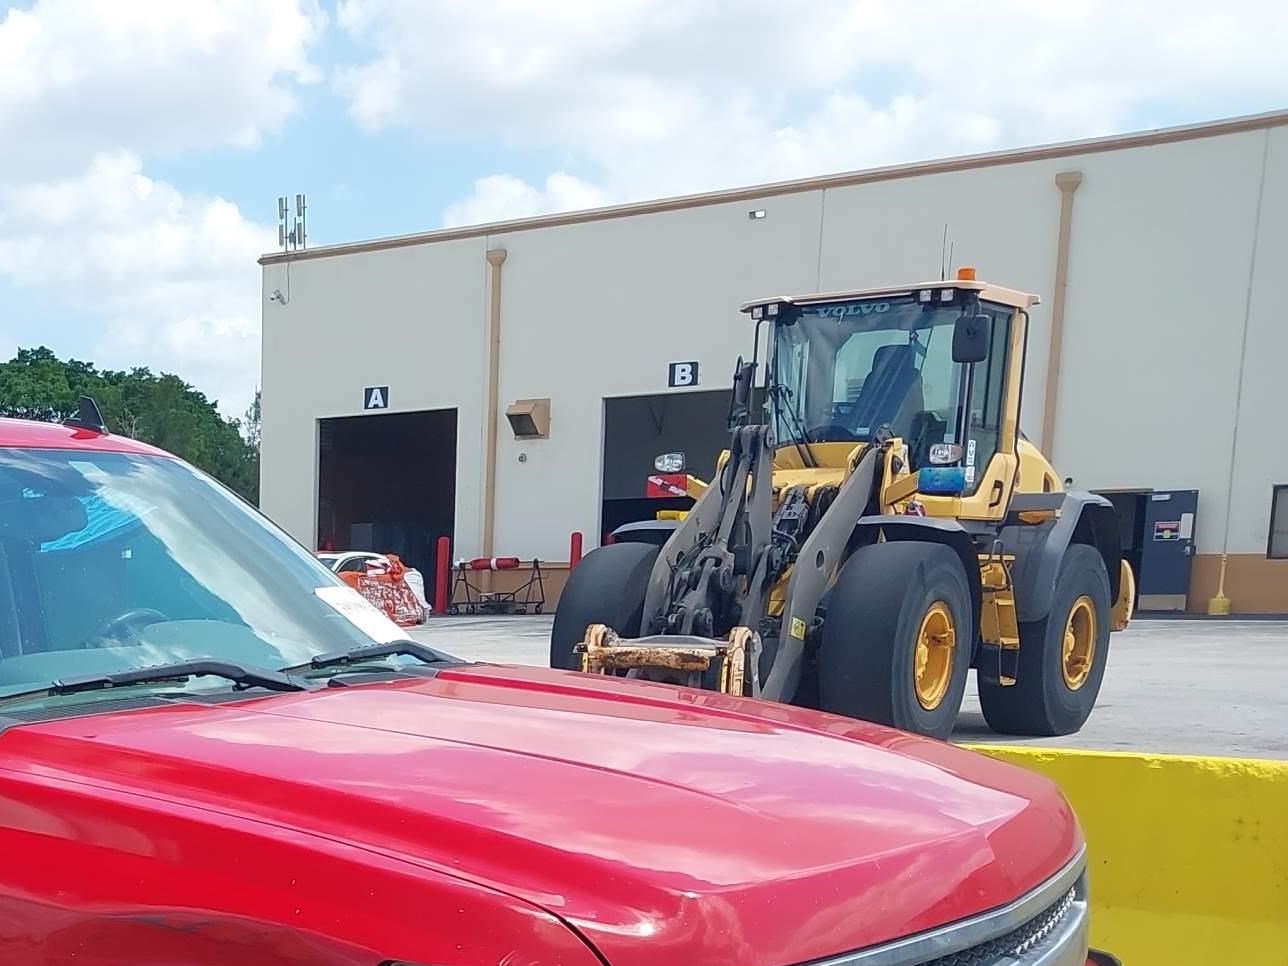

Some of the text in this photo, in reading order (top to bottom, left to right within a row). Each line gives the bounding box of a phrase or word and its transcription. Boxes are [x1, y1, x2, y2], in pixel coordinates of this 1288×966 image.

[816, 302, 890, 318] VOLVO
[674, 363, 694, 386] B
[367, 388, 385, 408] A
